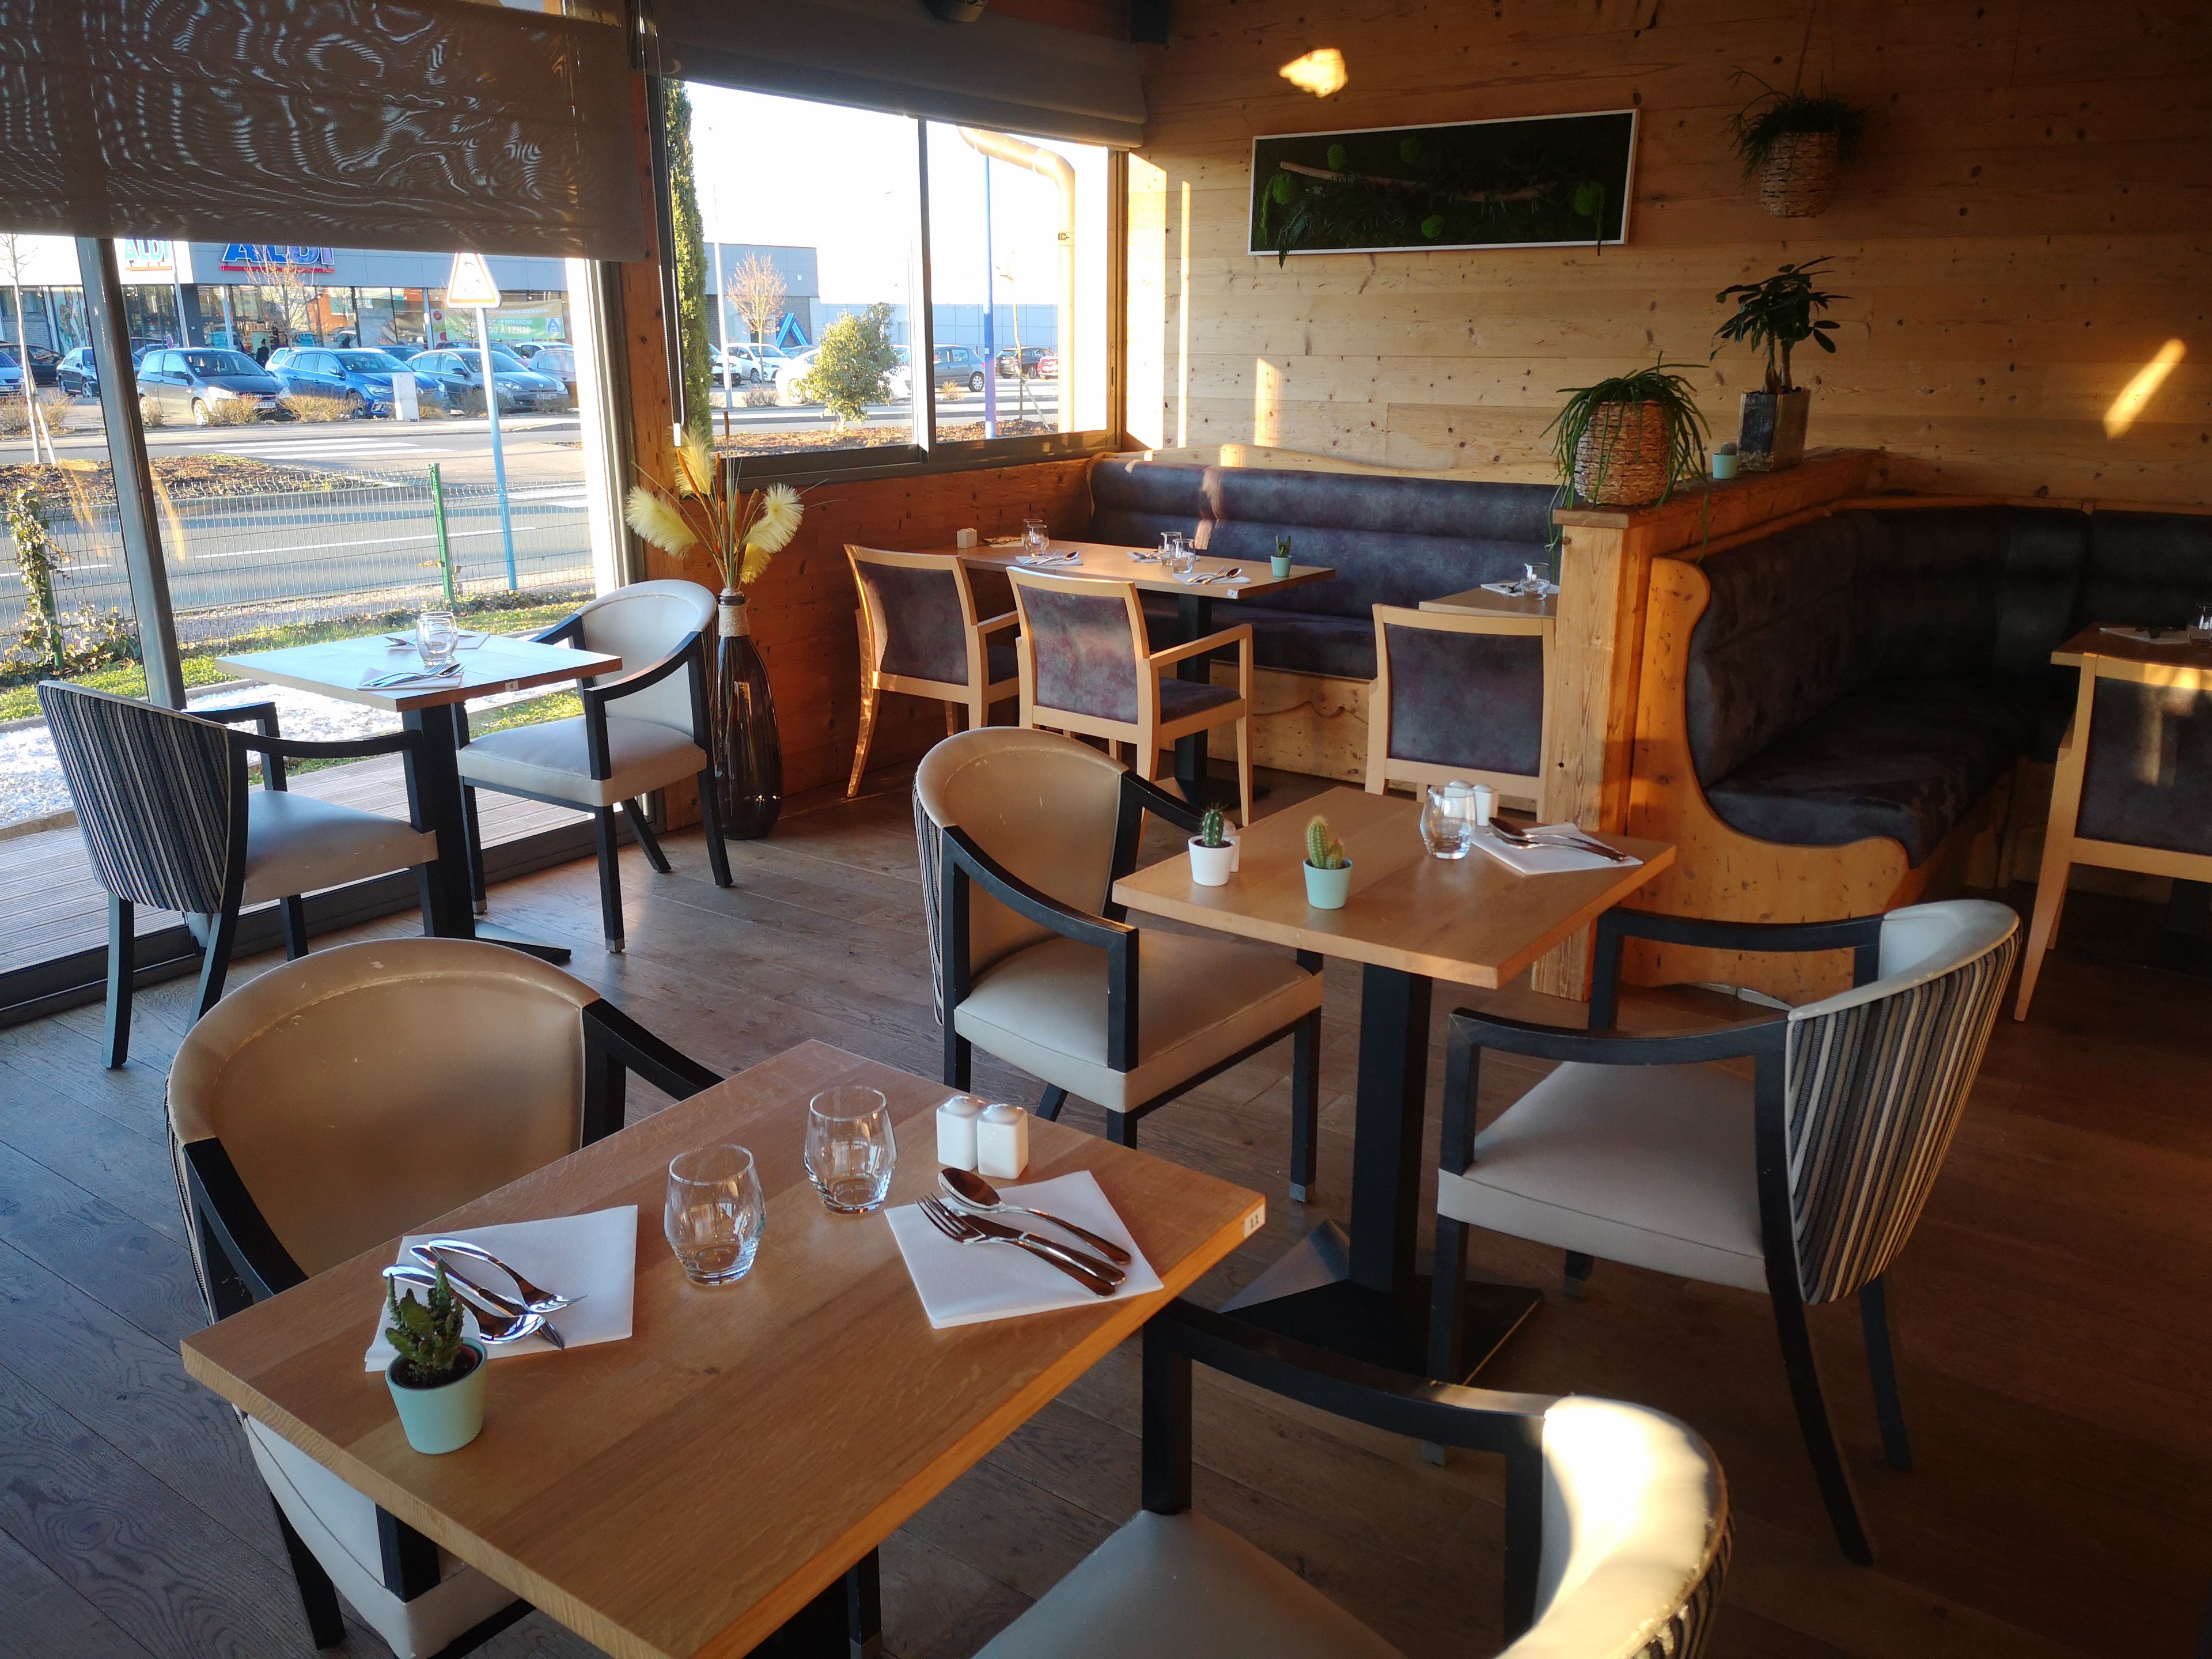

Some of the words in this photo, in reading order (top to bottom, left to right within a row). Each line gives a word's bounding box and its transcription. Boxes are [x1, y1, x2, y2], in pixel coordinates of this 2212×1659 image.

[124, 238, 170, 260] ALDI
[222, 243, 335, 265] ALDI
[1250, 1214, 1259, 1228] 11
